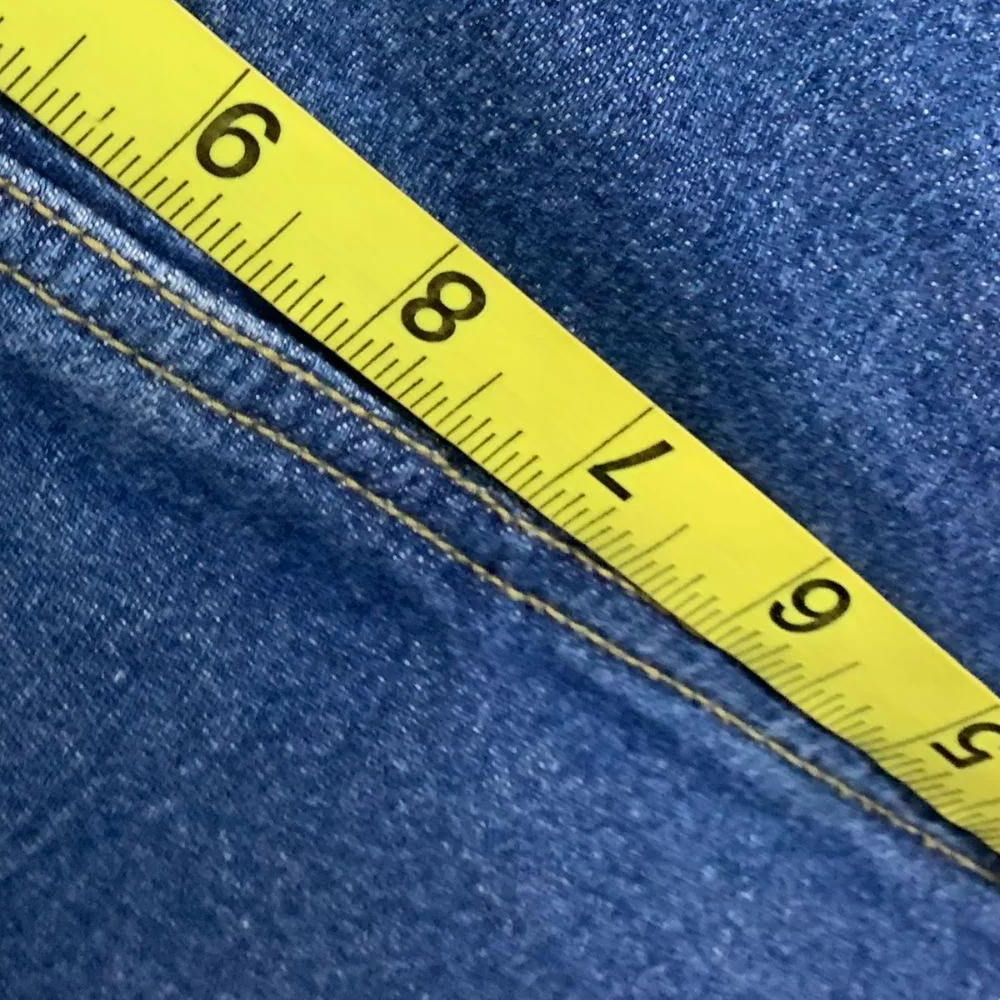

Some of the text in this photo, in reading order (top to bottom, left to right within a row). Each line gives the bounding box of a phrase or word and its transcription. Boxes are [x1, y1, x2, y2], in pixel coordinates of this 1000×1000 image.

[195, 102, 282, 178] 9
[400, 271, 486, 342] 8
[587, 440, 674, 501] 7
[769, 578, 851, 633] 6
[931, 721, 1000, 769] 5
